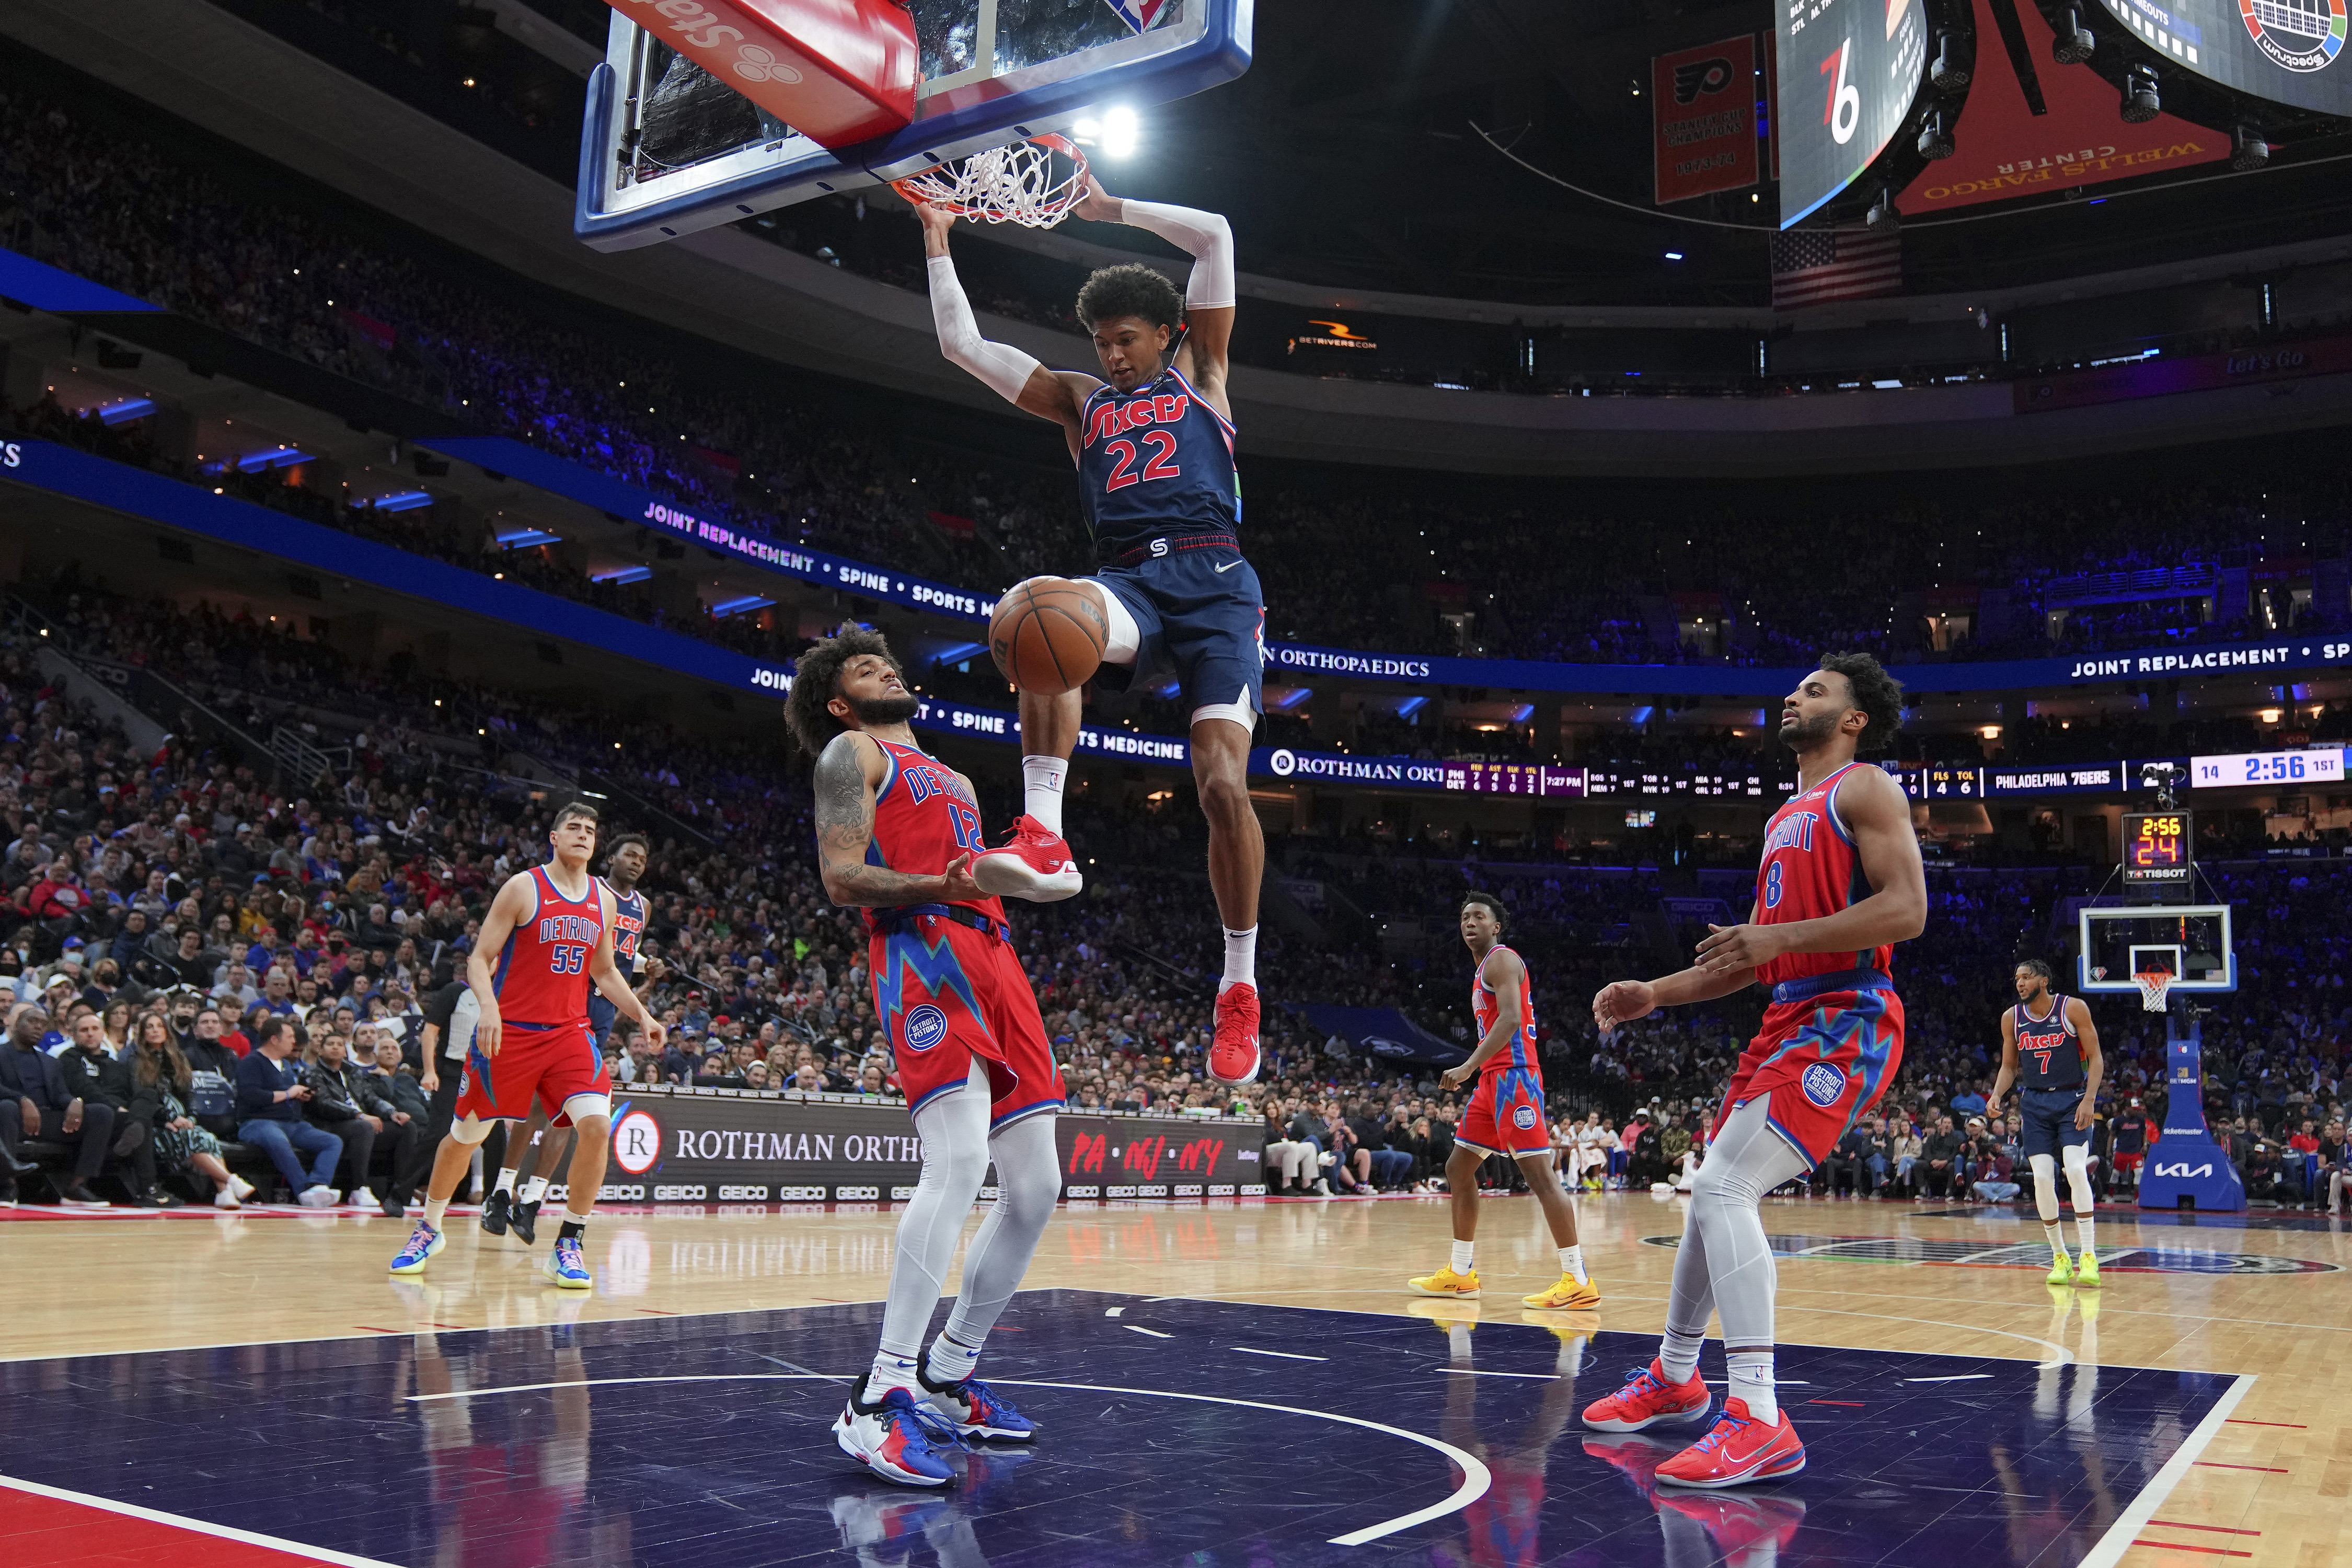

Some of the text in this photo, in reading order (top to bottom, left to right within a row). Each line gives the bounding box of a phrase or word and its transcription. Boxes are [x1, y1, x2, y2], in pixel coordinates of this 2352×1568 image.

[1791, 17, 1805, 36] STL
[2263, 39, 2330, 67] Spectrum
[1820, 37, 1860, 144] 76
[1664, 108, 1746, 134] STANLEY CUP
[1667, 122, 1743, 146] CHAMPIONS
[1676, 153, 1736, 176] 1973-74
[1924, 142, 2205, 200] WELLS FARGO
[1997, 146, 2116, 174] CENTER
[1148, 377, 1175, 397] crypto.com
[1104, 429, 1180, 493] 22
[644, 502, 695, 533] JOINT
[698, 521, 814, 572] REPLACEMENT
[839, 566, 889, 592] SPINE
[912, 585, 976, 614] SPORTS
[1281, 648, 1430, 676] ORTHOPAEDICS
[2071, 659, 2131, 677] JOINT
[2139, 647, 2289, 673] REPLACEMENT
[751, 668, 793, 691] JOIN
[952, 711, 1005, 734] SPINE
[1103, 734, 1184, 760] MEDICINE
[1297, 757, 1402, 780] ROTHMAN
[1448, 769, 1535, 784] PHI 7 4 1 2
[1910, 774, 1917, 783] 7
[1934, 770, 1974, 781] FLS TOL
[1996, 770, 2110, 789] PHILADELPHIA 76ERS
[2201, 756, 2334, 780] 14 2:56 1ST
[1446, 779, 1466, 790] DET
[1473, 781, 1481, 791] 6
[1527, 784, 1535, 793] 2
[1547, 776, 1582, 787] 7:27 PM
[1728, 781, 1740, 790] 1ST
[1910, 785, 1917, 794] 0
[1936, 781, 1970, 794] 4 6
[1806, 790, 1826, 800] UWM
[948, 803, 986, 853] 12
[2142, 818, 2181, 836] 2:56
[2137, 836, 2177, 866] 24
[1766, 861, 1782, 908] 8
[2143, 869, 2187, 879] TISSOT
[539, 915, 601, 949] DETROIT
[550, 944, 586, 975] 55
[911, 1016, 936, 1033] DETROIT
[913, 1023, 938, 1040] PISTONS
[2034, 1050, 2051, 1074] 7
[1807, 1073, 1836, 1099] PISTONS
[1813, 1065, 1843, 1090] DETROIT
[628, 1128, 924, 1162] R ROTHMAN ORTH
[1069, 1132, 1224, 1180] PA NJ NY
[1237, 1149, 1260, 1163] betway
[2155, 1162, 2213, 1178] KIA
[654, 1185, 707, 1200] GEICO
[718, 1185, 768, 1200] GEICO
[780, 1186, 826, 1201] GEICO
[836, 1186, 880, 1200] GEICO
[1067, 1185, 1099, 1198] GEICO
[1106, 1185, 1137, 1197] GEICO
[1137, 1185, 1168, 1197] GEICO
[1174, 1184, 1203, 1196] GEICO
[1208, 1184, 1236, 1196] GEICO
[1240, 1184, 1266, 1196] GEICO
